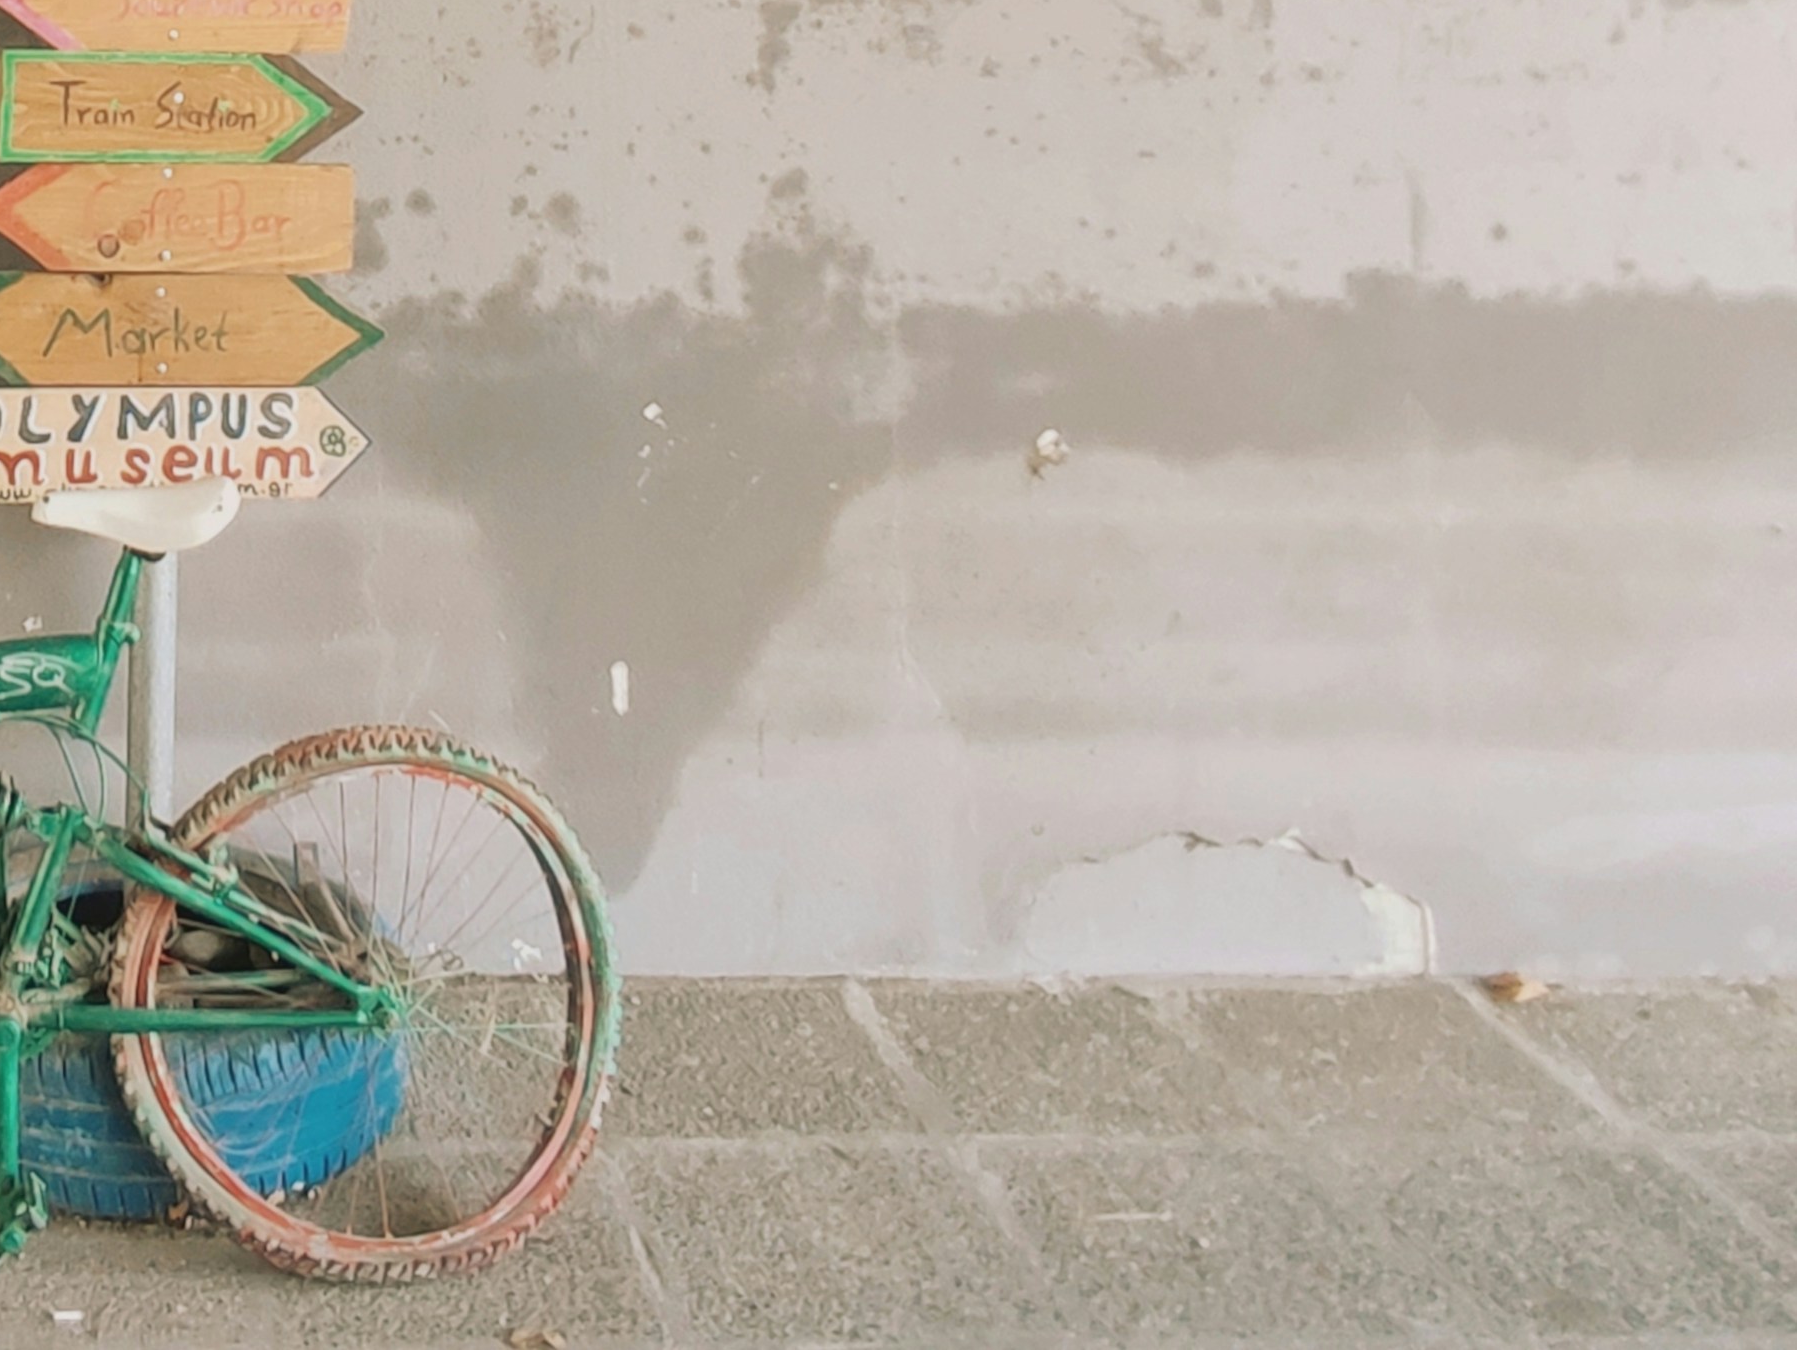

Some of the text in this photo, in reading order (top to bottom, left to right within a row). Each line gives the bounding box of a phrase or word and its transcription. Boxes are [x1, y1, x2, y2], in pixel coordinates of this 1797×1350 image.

[49, 80, 257, 131] Train Station
[211, 178, 292, 251] Bar
[41, 306, 230, 358] Market
